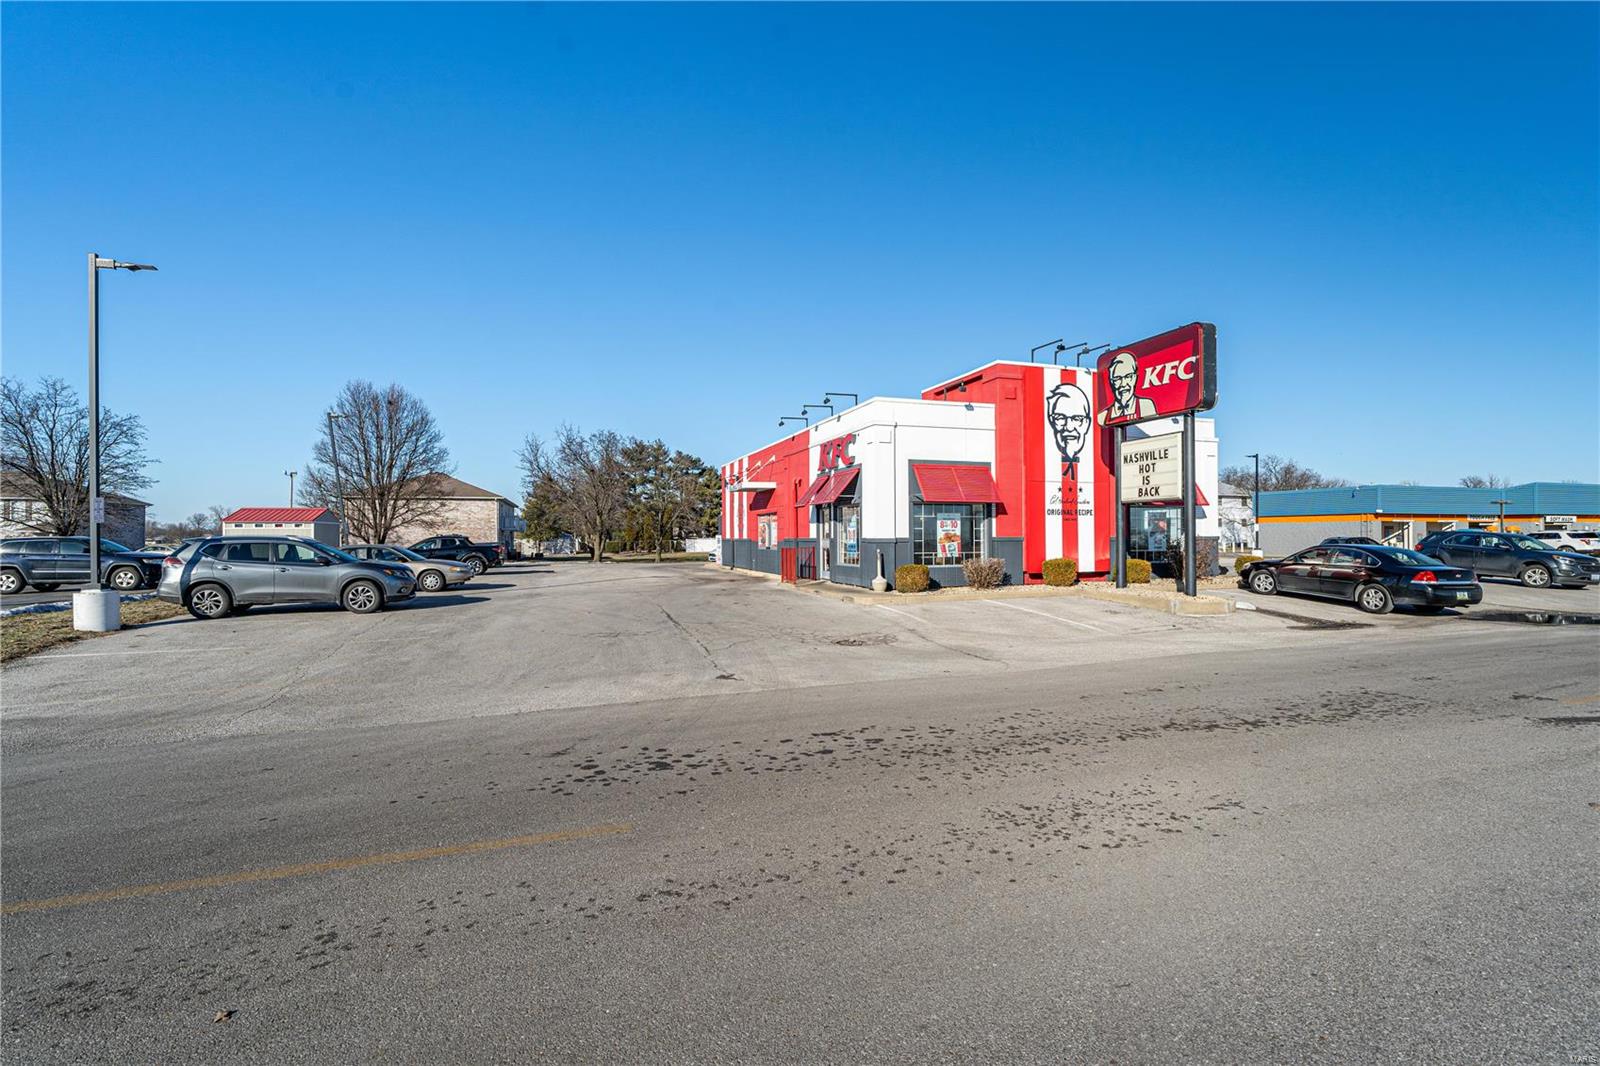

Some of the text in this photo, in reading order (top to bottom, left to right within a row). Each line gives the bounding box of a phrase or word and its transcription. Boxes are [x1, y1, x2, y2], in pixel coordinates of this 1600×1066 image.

[1142, 356, 1197, 389] KFC
[817, 433, 857, 471] KFC
[1123, 449, 1169, 464] NASHVILLE
[1138, 462, 1156, 474] HOT
[1142, 475, 1150, 485] IS
[1138, 486, 1160, 497] BACK
